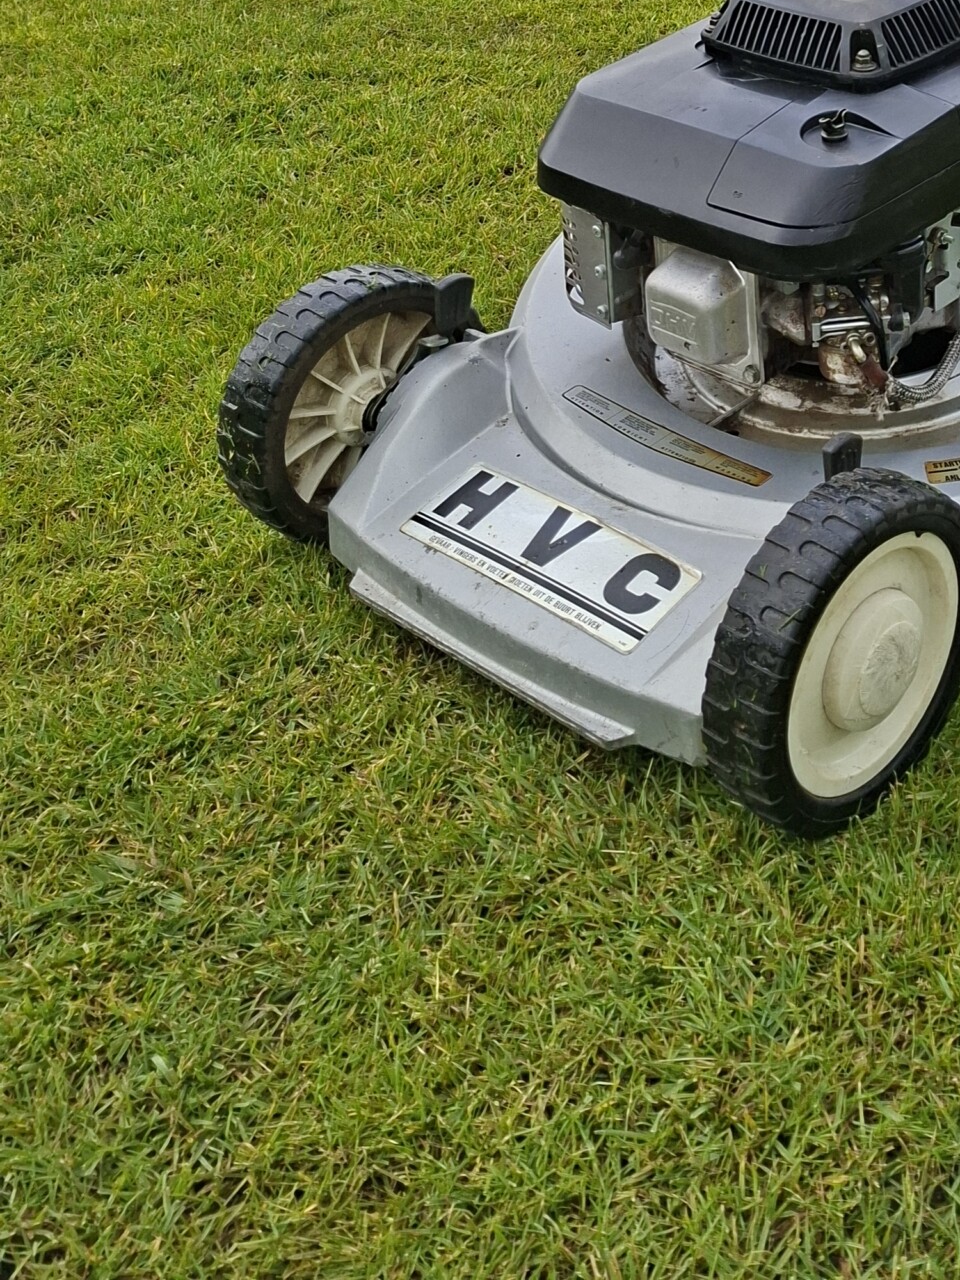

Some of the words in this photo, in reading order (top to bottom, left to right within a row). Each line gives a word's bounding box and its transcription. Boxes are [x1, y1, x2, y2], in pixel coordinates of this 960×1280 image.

[429, 535, 451, 549] GEVAAR
[453, 546, 479, 563] VINGERS
[476, 559, 487, 568] EN
[486, 563, 510, 580] VOETE
[532, 589, 547, 599] UIT
[544, 595, 555, 604] DE
[553, 600, 576, 616] BUURT
